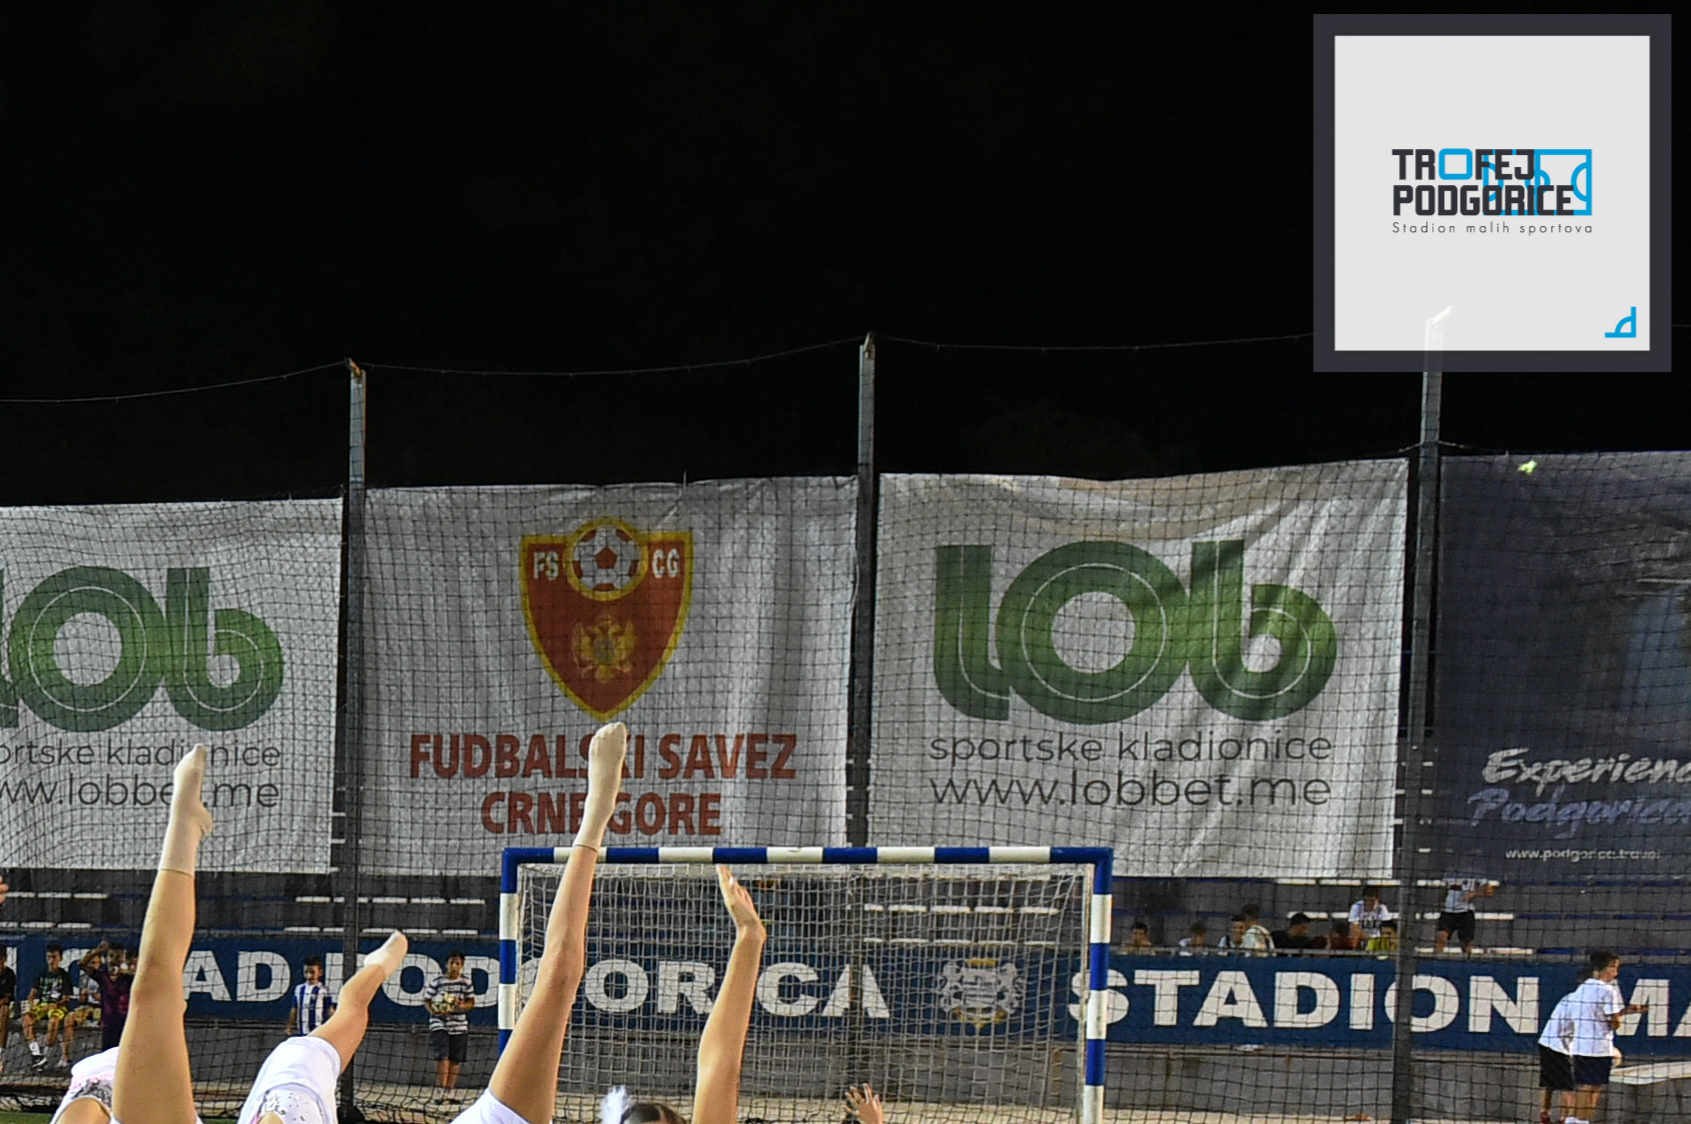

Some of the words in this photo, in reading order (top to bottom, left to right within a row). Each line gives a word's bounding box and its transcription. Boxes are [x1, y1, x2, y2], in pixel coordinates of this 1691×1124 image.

[533, 550, 559, 580] FS
[652, 549, 680, 578] CG
[107, 739, 281, 766] kladinice
[410, 734, 645, 779] FUDBALI
[657, 734, 797, 779] SAVEZ
[929, 731, 1104, 767] sportske
[1118, 730, 1333, 761] kladionice
[928, 771, 1332, 806] www.lobbet.me
[481, 791, 590, 834] CRNE
[607, 791, 722, 835] GORE
[324, 952, 891, 1019] ODORCA
[1068, 969, 1540, 1034] STADION
